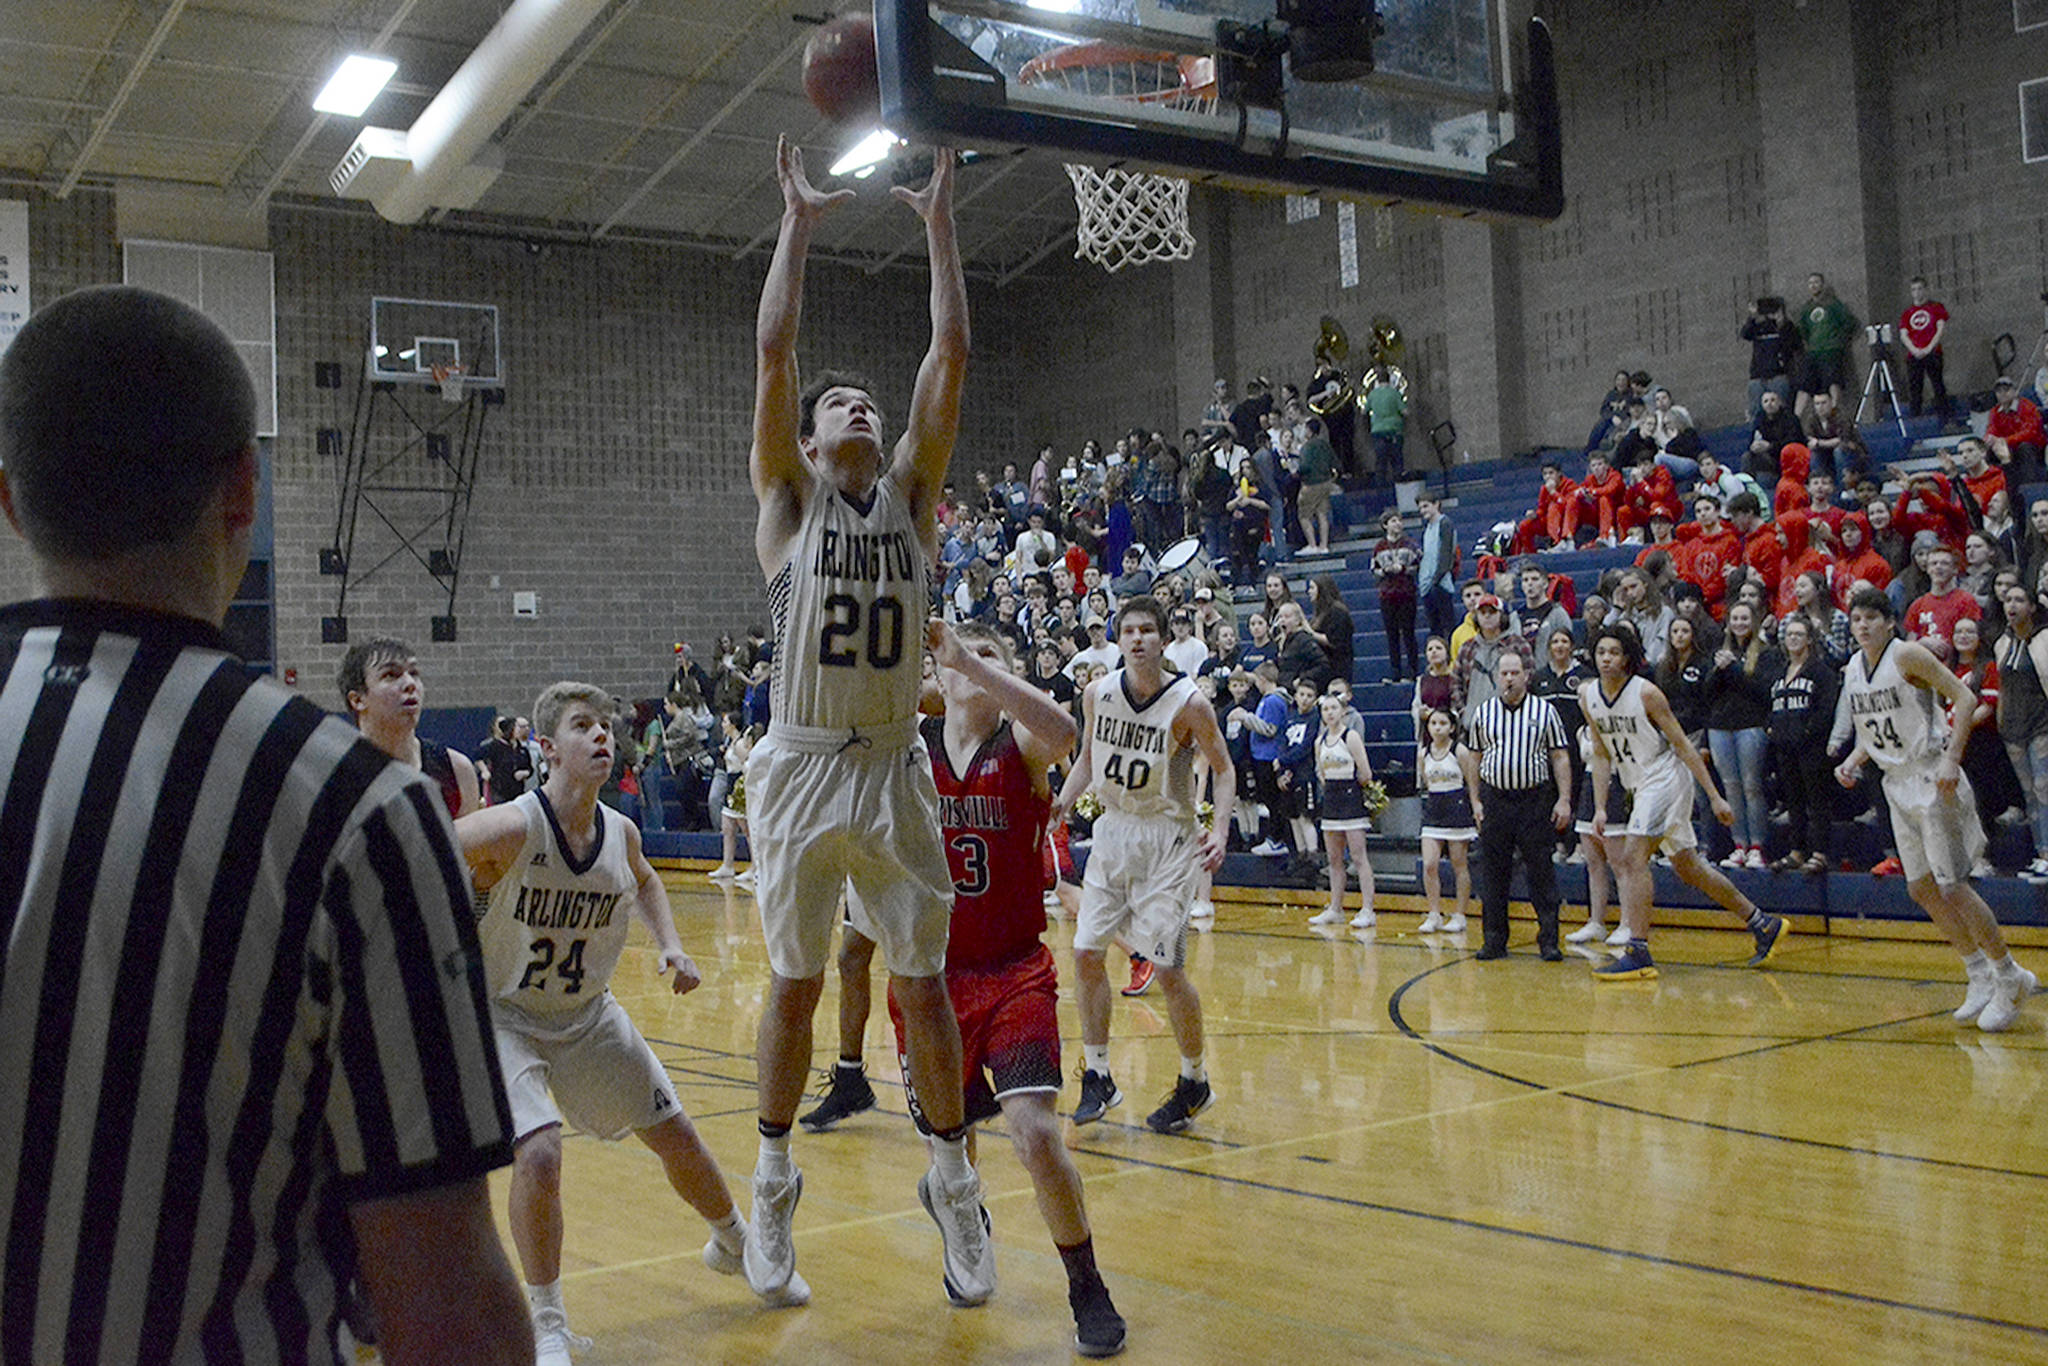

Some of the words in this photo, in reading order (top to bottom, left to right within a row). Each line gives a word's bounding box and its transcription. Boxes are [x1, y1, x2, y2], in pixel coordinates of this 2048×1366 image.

[819, 594, 904, 669] 20
[1611, 737, 1636, 763] 14
[1864, 716, 1903, 750] 34
[1104, 754, 1151, 790] 40
[951, 833, 991, 896] 3
[518, 938, 589, 993] 24
